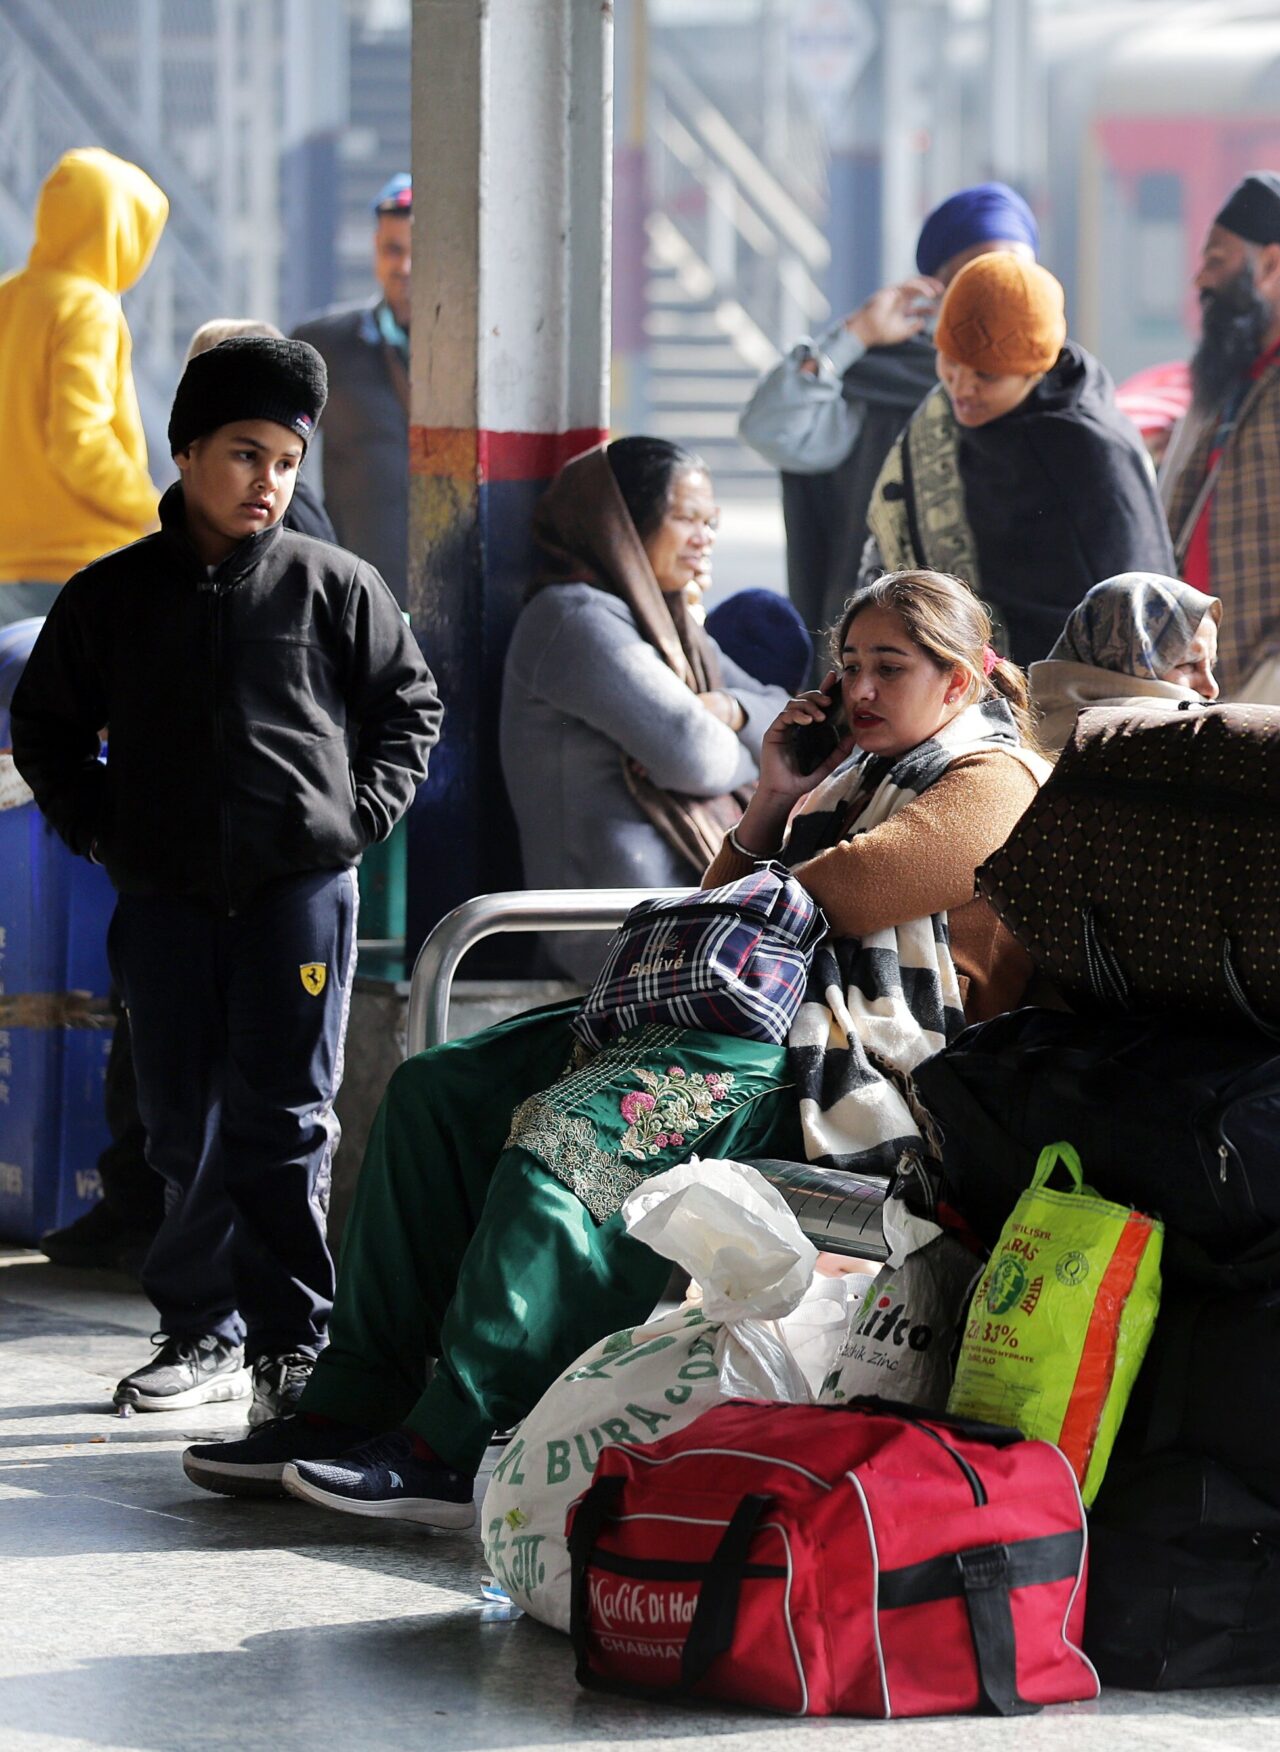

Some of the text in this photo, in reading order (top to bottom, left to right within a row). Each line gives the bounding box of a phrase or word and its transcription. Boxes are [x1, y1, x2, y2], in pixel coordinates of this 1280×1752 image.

[982, 1321, 1019, 1349] 33%
[866, 1350, 899, 1372] Zinc
[586, 1572, 645, 1630] Malik
[648, 1592, 666, 1624] Di
